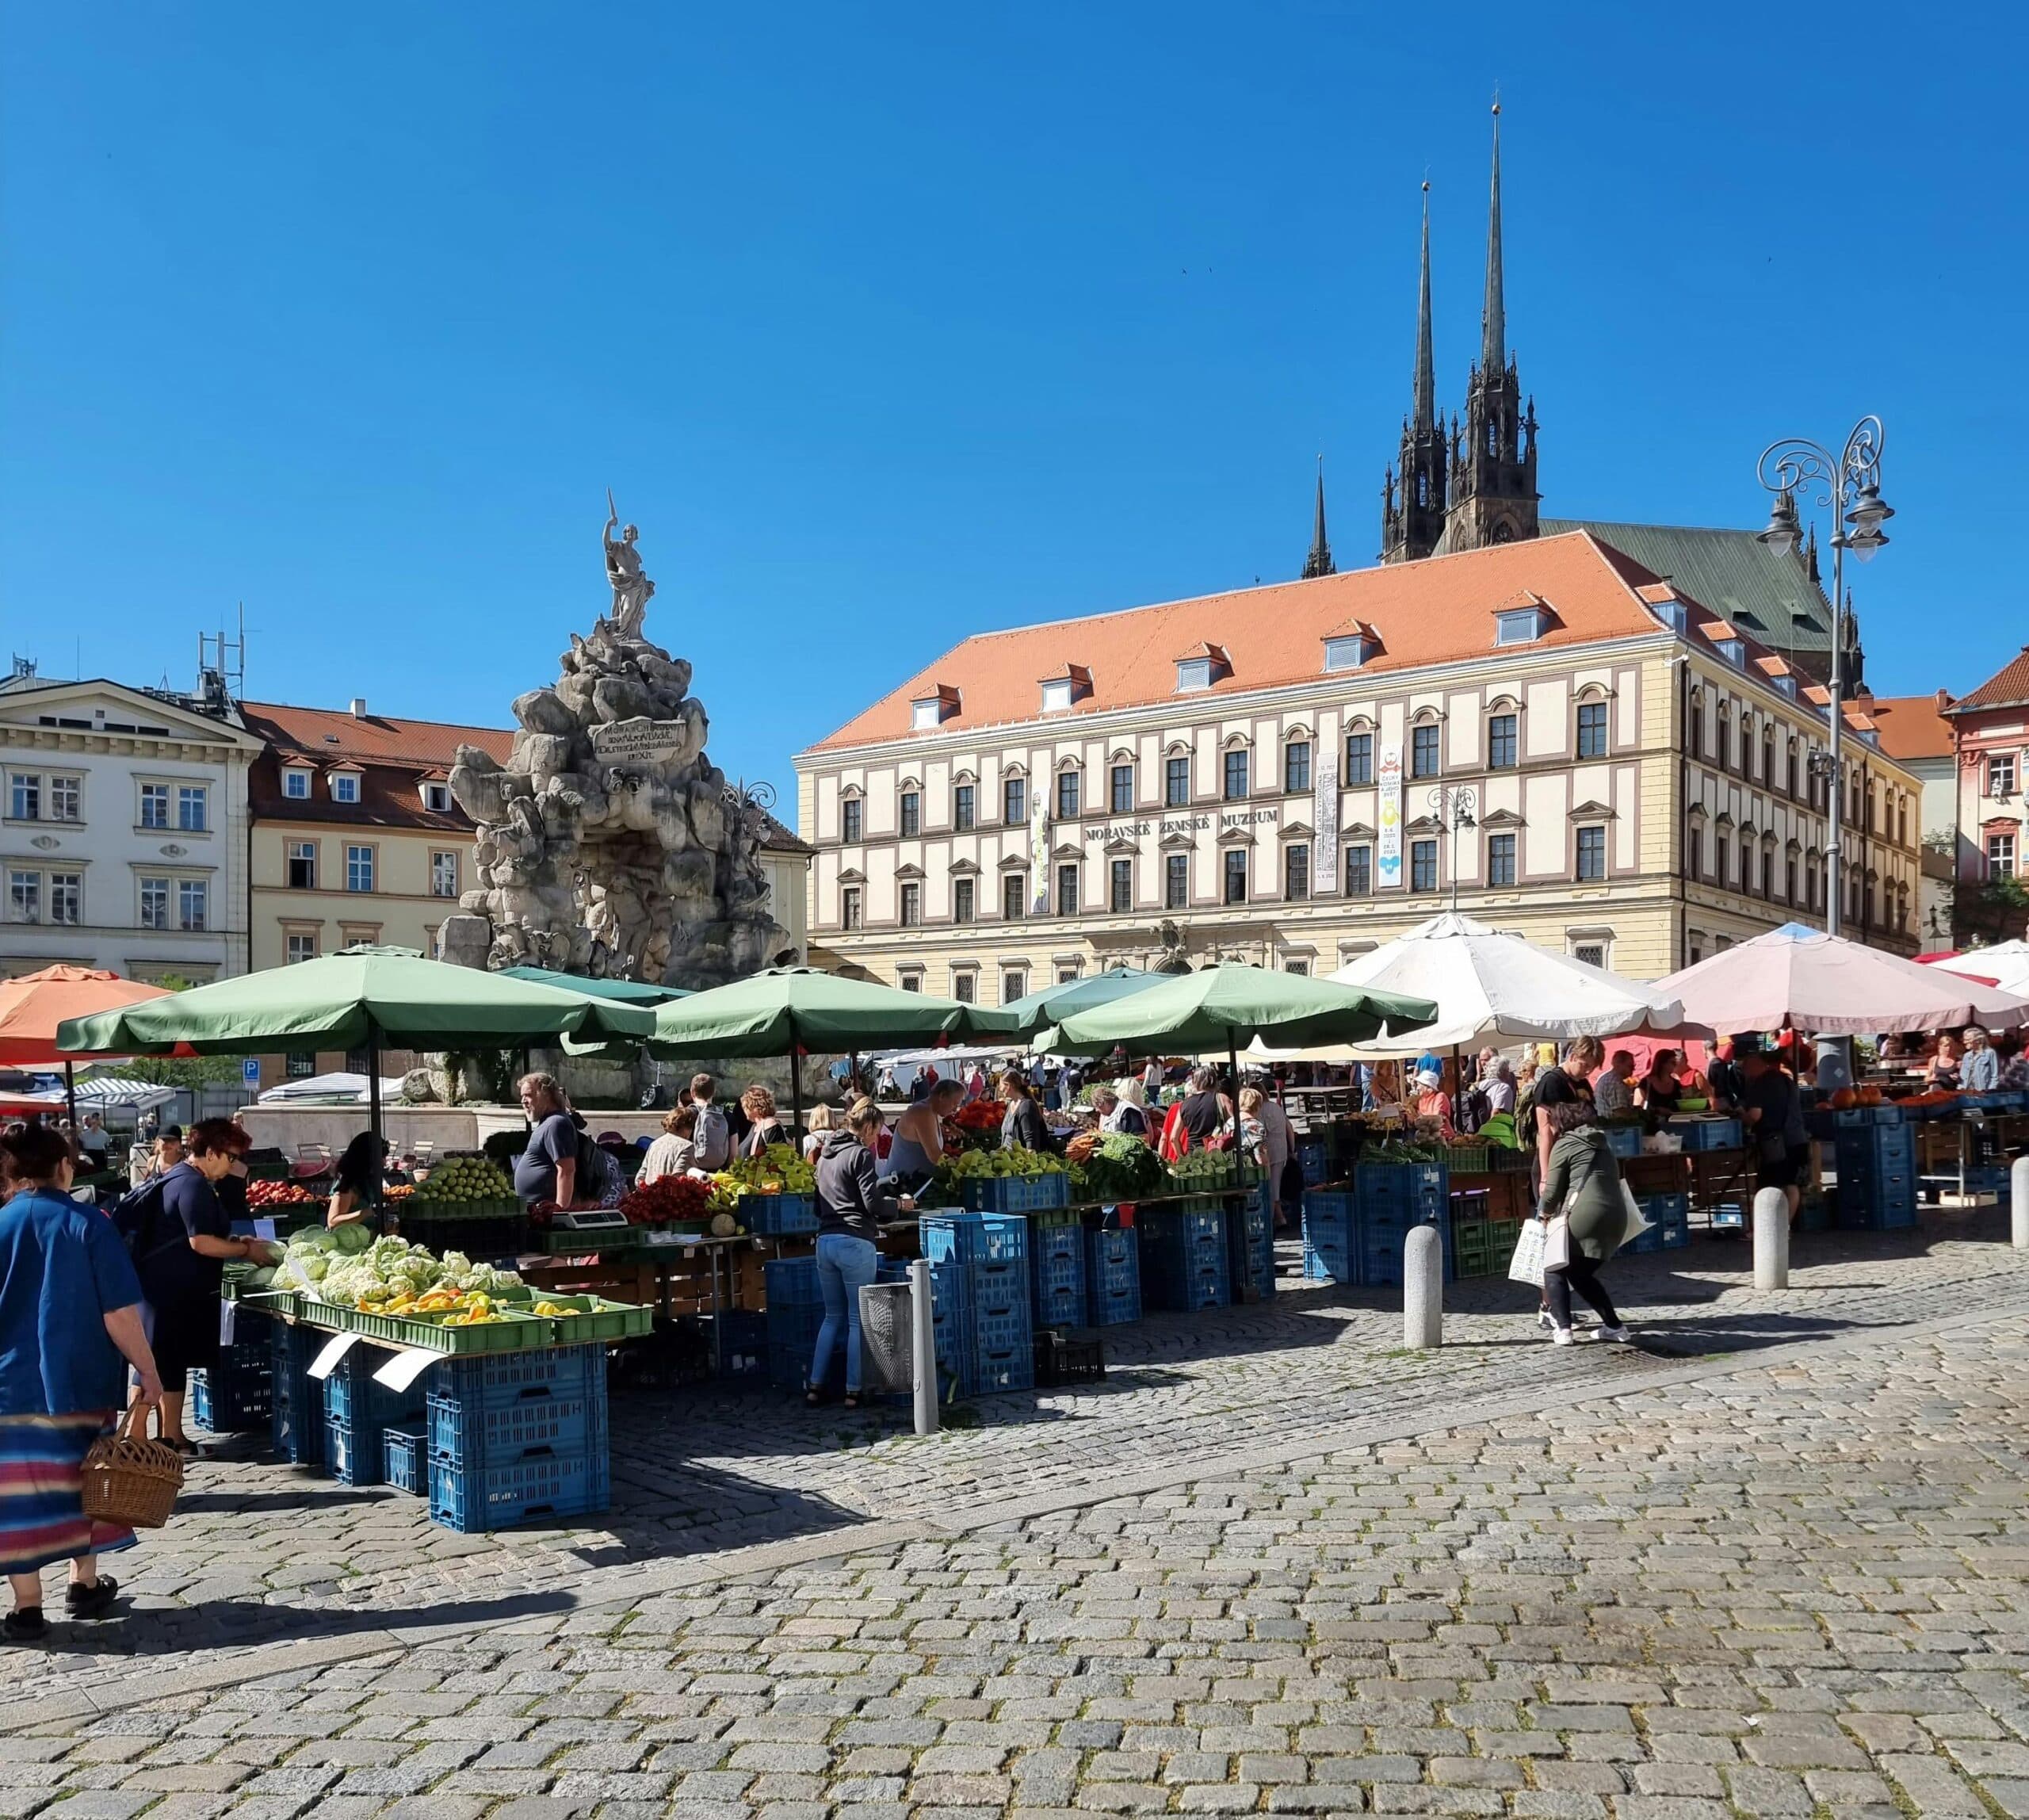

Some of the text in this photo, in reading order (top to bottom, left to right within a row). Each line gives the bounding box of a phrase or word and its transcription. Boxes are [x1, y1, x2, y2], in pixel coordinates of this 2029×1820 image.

[1086, 810, 1278, 841] MORAVSKÉ ZEMSKÉ MUZEUM
[246, 1061, 256, 1075] P
